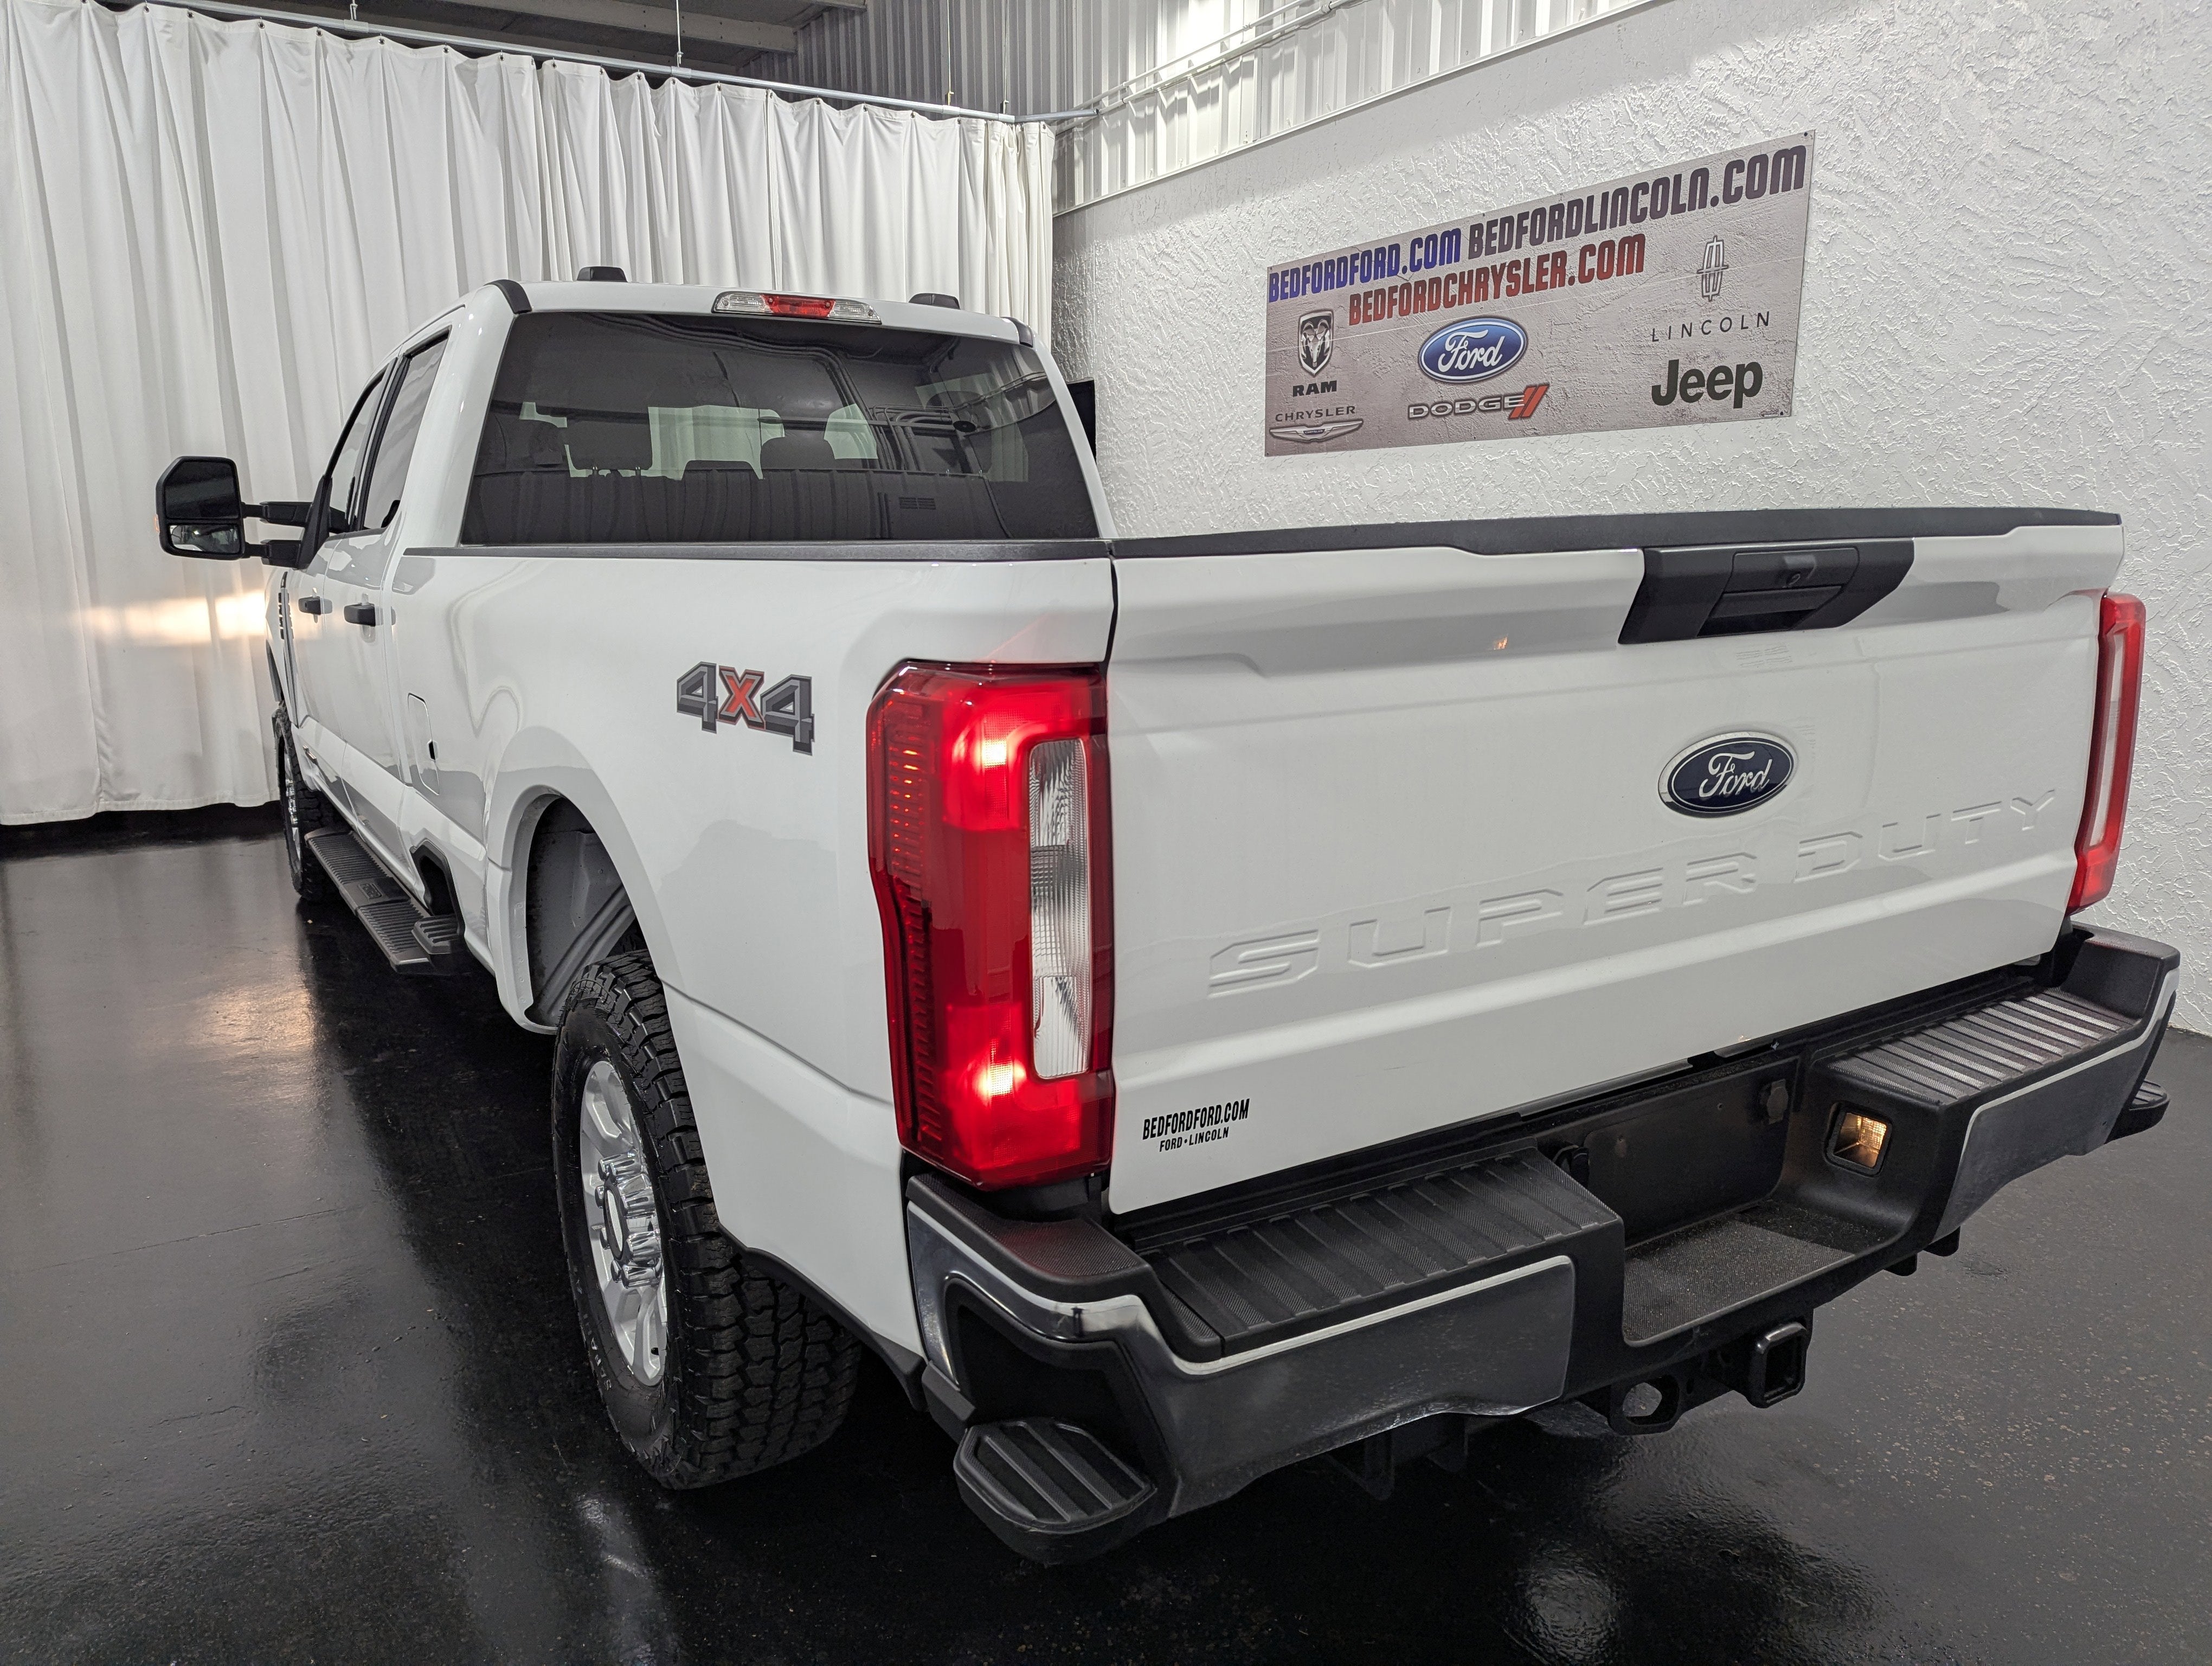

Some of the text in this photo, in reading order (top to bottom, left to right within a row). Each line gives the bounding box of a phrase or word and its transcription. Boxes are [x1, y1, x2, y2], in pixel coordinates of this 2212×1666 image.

[1269, 145, 1806, 303] BEDFORDFORD.COM BEDFORDLINCOLN.COM
[1349, 233, 1645, 325] BEDFORDCHRYSLER.COM
[1652, 311, 1769, 342] LINCOLN
[1438, 329, 1505, 372] Ford
[1293, 380, 1337, 397] RAM
[1651, 359, 1763, 409] Jeep
[1275, 406, 1355, 422] CHRYSLER
[1409, 394, 1525, 419] DODGE
[1699, 751, 1773, 798] Ford
[1208, 789, 2055, 999] SUPER DUTY
[1142, 1098, 1250, 1140] BEDFORDFORD.COM
